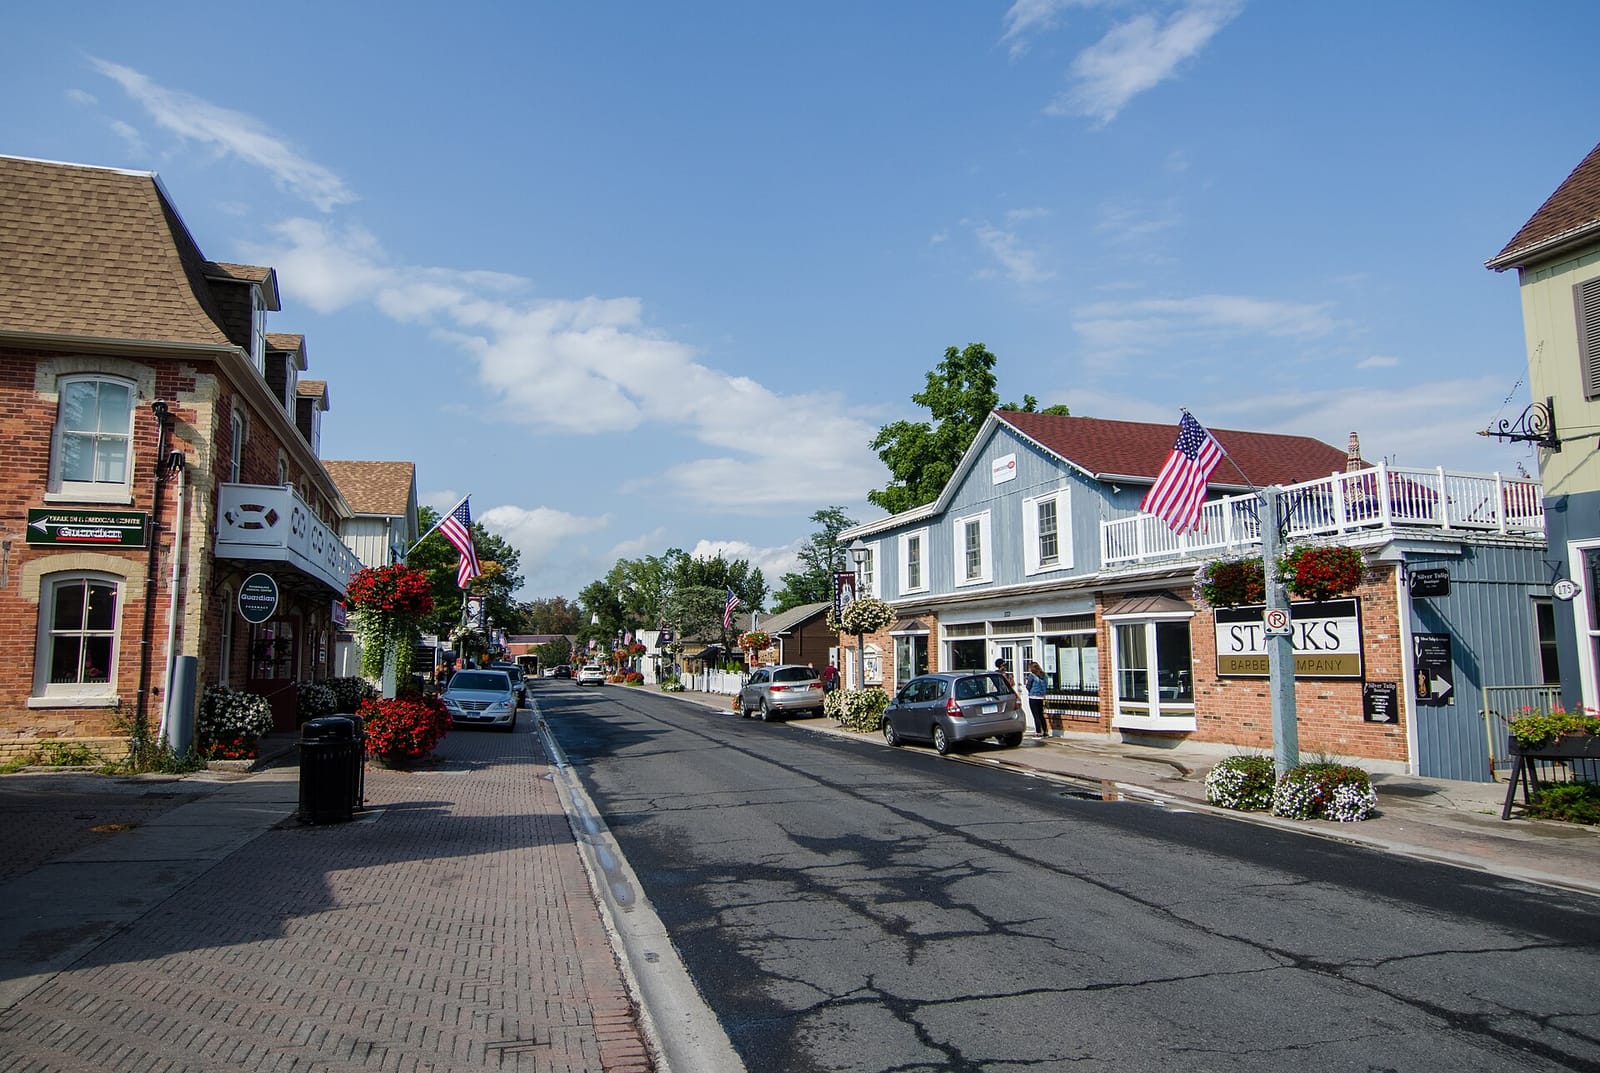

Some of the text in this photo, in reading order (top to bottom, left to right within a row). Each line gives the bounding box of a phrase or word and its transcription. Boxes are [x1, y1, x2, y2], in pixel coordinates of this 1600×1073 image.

[56, 527, 122, 538] Guardian
[1558, 584, 1572, 595] 175
[241, 593, 275, 602] Guardian
[1231, 659, 1342, 671] BARBE MPANY
